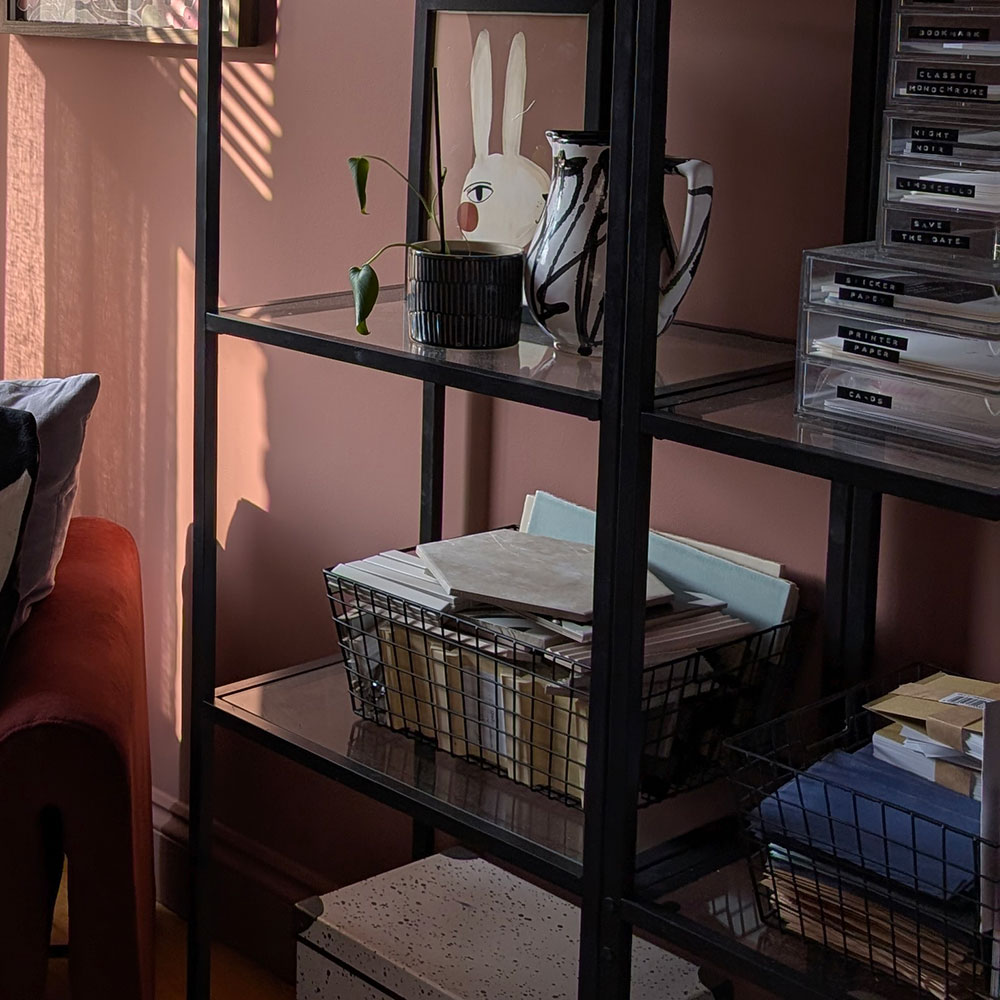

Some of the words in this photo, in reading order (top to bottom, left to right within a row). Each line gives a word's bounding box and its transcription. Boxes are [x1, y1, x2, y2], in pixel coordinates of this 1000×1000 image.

[918, 29, 981, 38] BOOKMARK
[918, 70, 973, 81] CLASSIC
[908, 84, 985, 97] MONOCHROME
[913, 129, 950, 140] NIGHT
[915, 144, 944, 154] NOIR
[913, 219, 943, 230] SAVE
[901, 232, 923, 243] THE
[931, 235, 962, 246] DATE
[845, 276, 897, 292] SICKER
[849, 291, 886, 305] PAPE
[847, 329, 900, 348] PRINTER
[852, 343, 890, 359] PAPER
